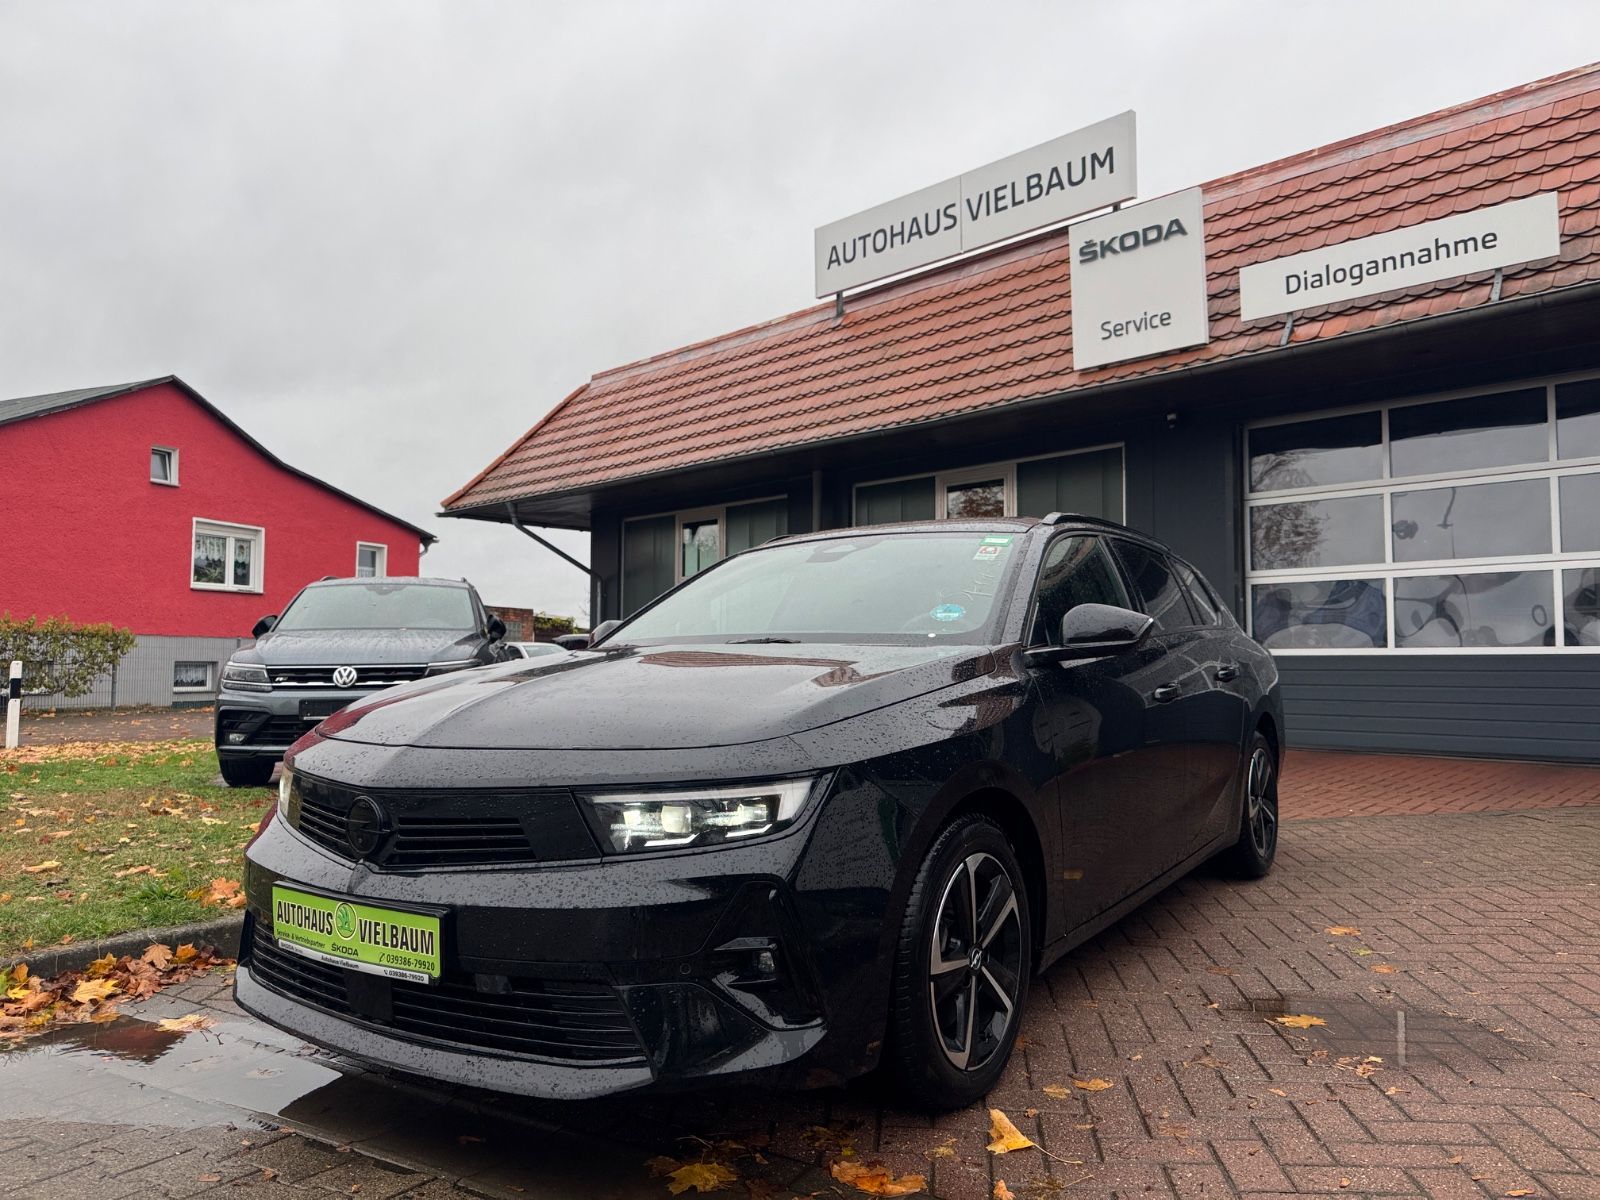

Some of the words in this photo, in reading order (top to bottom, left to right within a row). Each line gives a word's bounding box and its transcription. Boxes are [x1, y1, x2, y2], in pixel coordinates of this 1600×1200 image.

[826, 203, 957, 270] AUTOHAUS
[966, 147, 1114, 221] VIELBAUM
[1079, 218, 1188, 264] ŠKODA
[1285, 231, 1498, 295] Dialogannahme
[1101, 311, 1172, 340] Service
[277, 900, 333, 935] AUTOHAUS
[359, 918, 434, 956] VIELBAUM
[331, 943, 359, 957] ŠKODA
[386, 954, 435, 971] 039386-79920
[389, 970, 425, 982] 039386-79920
